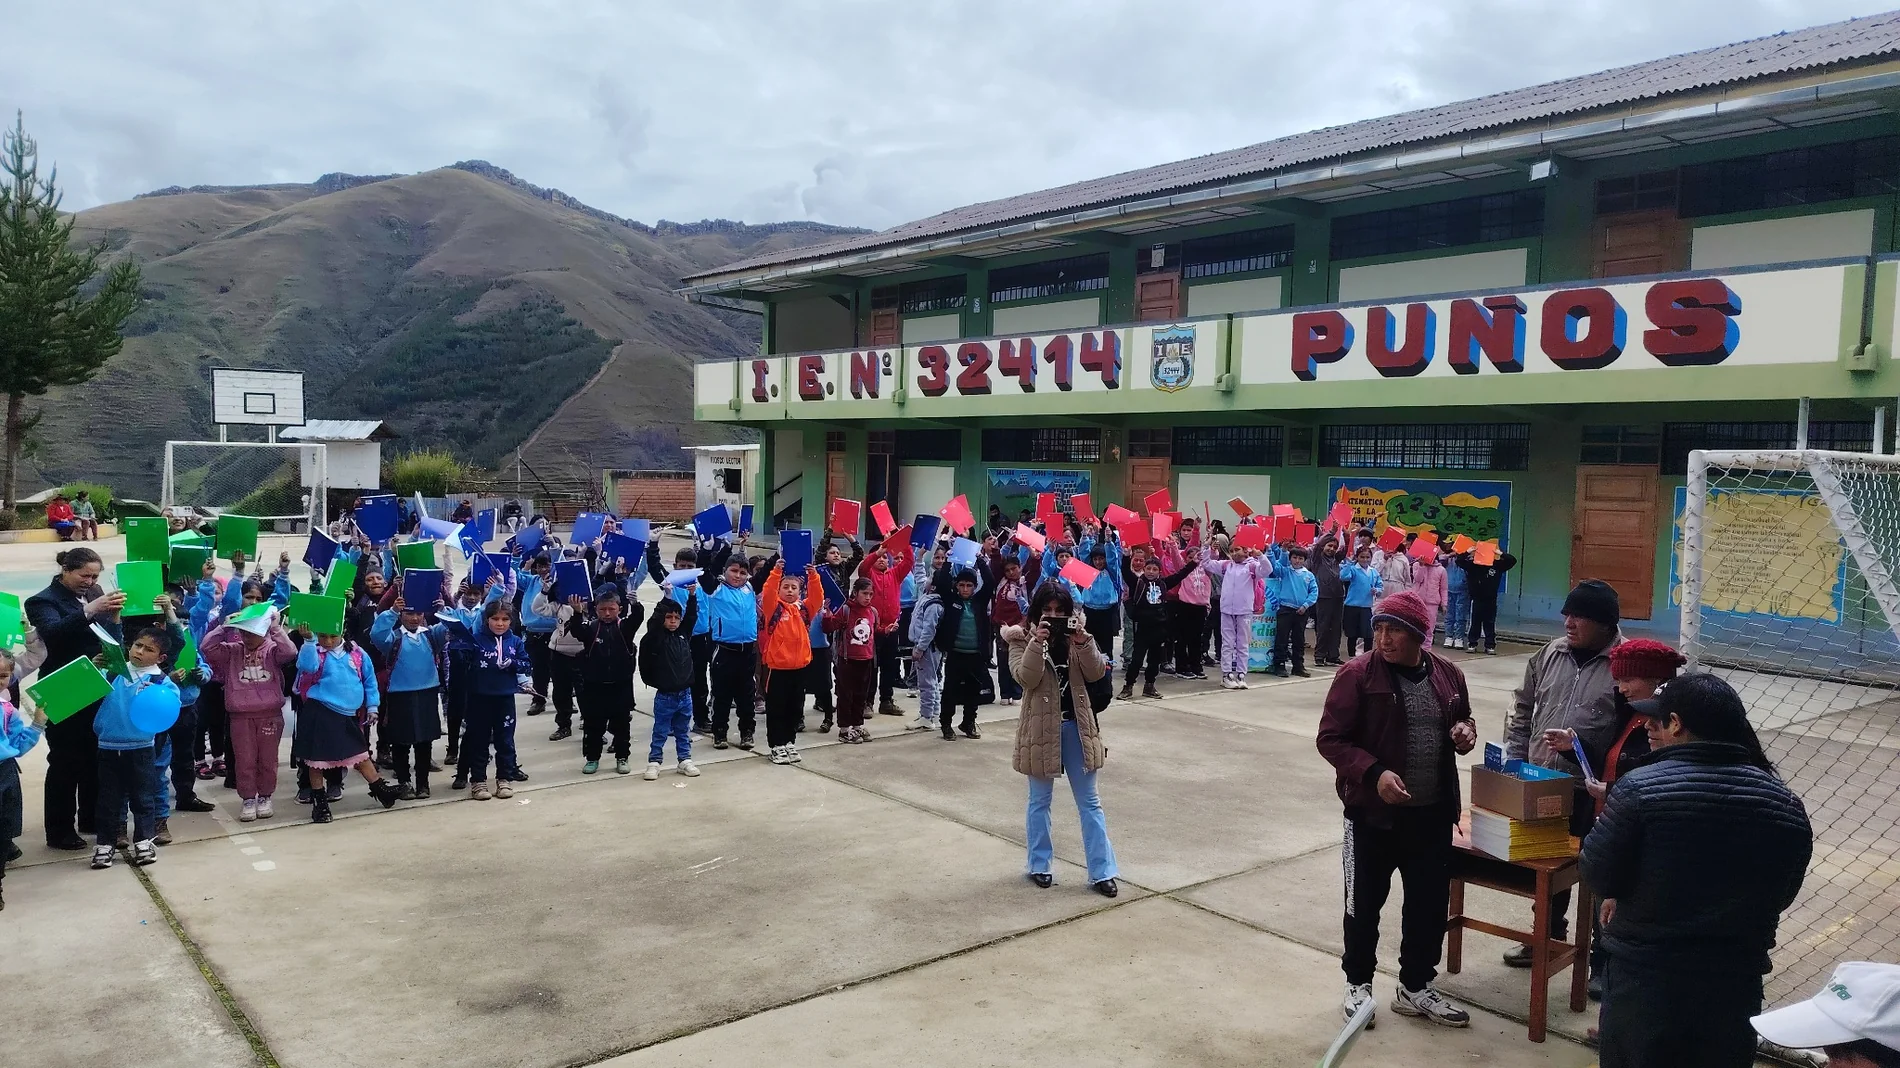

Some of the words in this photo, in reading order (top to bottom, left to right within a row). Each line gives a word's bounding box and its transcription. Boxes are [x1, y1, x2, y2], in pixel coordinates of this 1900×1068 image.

[751, 360, 779, 402] I.
[798, 355, 835, 399] E.
[916, 331, 1122, 395] 32414
[1292, 278, 1742, 381] PUÑOS
[1360, 488, 1369, 496] LA
